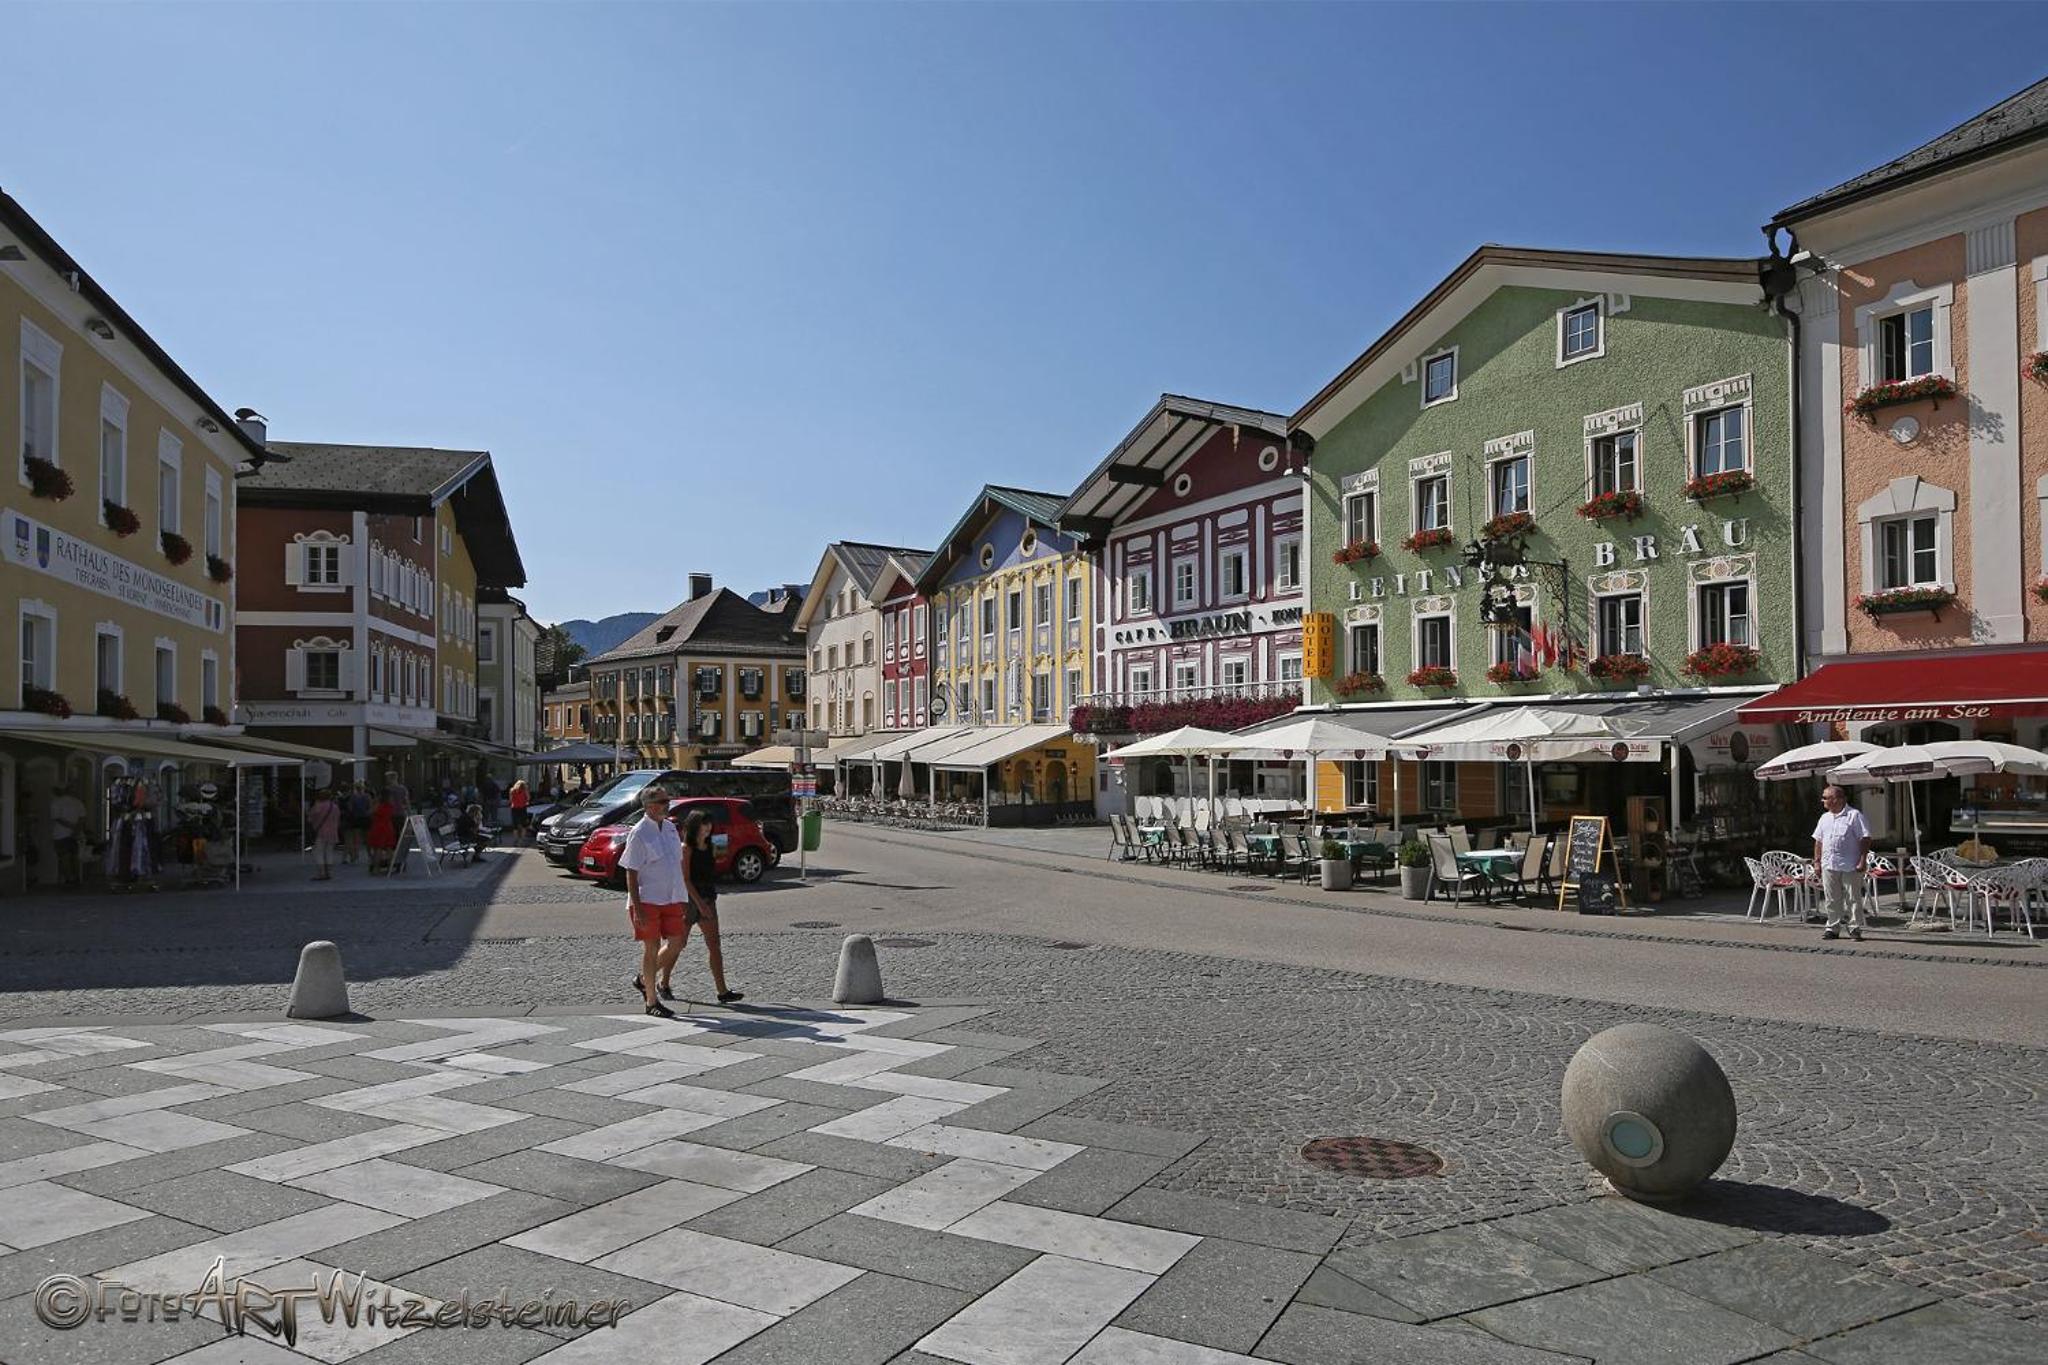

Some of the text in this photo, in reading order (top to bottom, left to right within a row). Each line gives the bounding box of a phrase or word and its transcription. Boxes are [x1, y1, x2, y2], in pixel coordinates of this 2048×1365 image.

[1593, 519, 1749, 567] BRÄU
[56, 537, 108, 574] RATHAUS
[113, 560, 130, 583] DES
[133, 573, 204, 612] MONDSEELANDES
[1170, 610, 1253, 639] BRAUN
[1305, 613, 1316, 669] HOTEL
[1321, 613, 1331, 668] HOTEL
[1794, 703, 1992, 723] Ambiente am See
